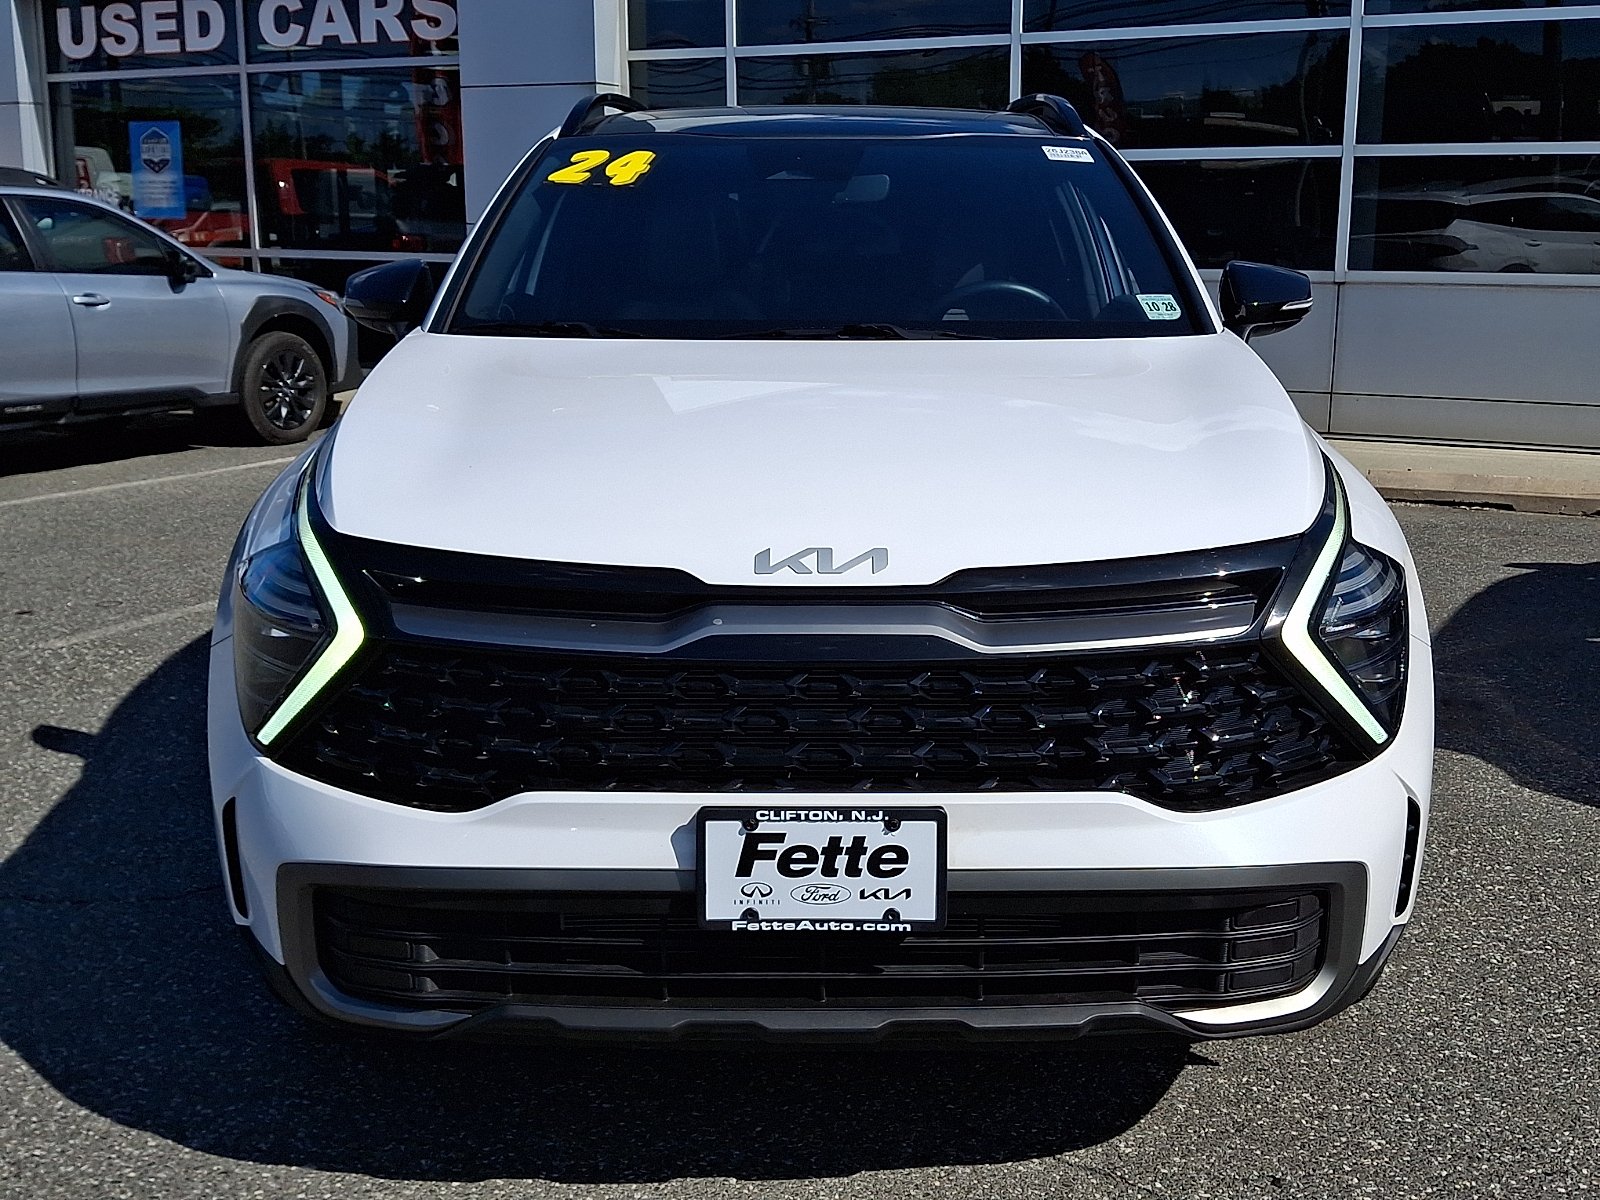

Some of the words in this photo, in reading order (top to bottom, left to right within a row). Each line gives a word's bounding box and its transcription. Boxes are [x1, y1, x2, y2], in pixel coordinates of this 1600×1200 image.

[56, 0, 226, 60] USED
[257, 0, 458, 48] CARS
[547, 149, 656, 186] 24
[1144, 301, 1161, 312] 10
[1161, 301, 1177, 312] 28
[755, 810, 844, 821] CLIFTON,
[851, 810, 890, 821] N.J.
[734, 831, 910, 879] Fette
[801, 886, 841, 902] Ford
[732, 920, 912, 931] FetteAuto.com
